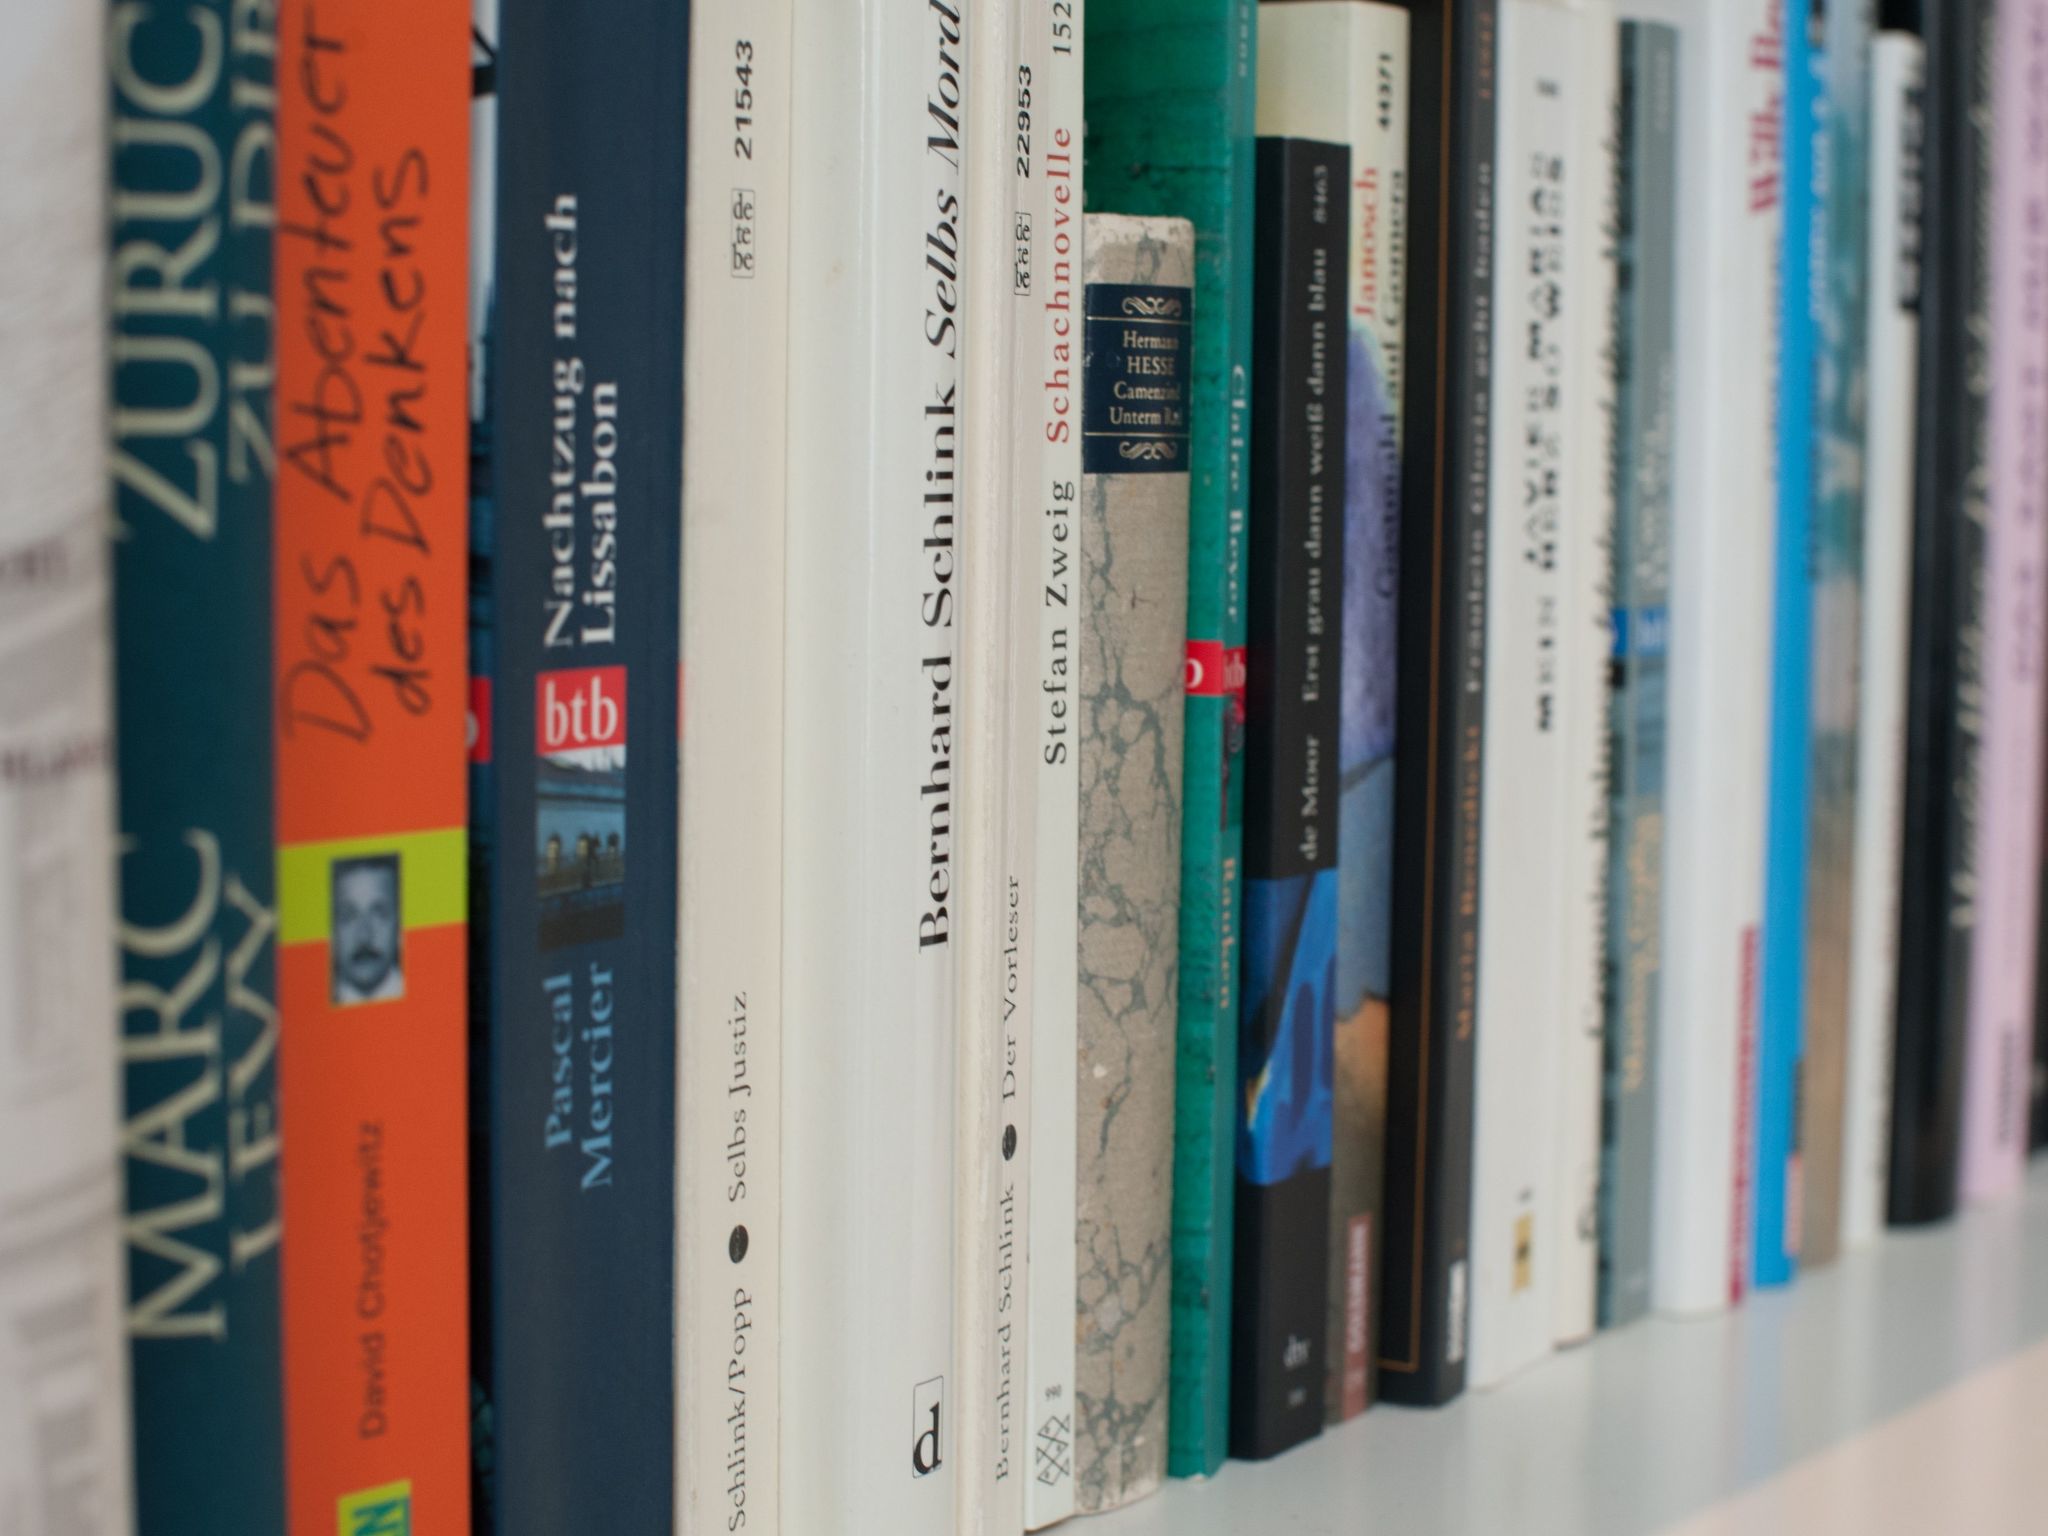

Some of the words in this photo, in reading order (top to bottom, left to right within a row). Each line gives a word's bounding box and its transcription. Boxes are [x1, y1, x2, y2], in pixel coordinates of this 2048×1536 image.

[735, 39, 753, 160] 21543
[927, 0, 962, 177] Mord
[1016, 64, 1032, 179] 22953
[281, 0, 365, 502] Abenteuer
[545, 194, 578, 338] nach
[925, 188, 959, 359] Selbs
[1046, 127, 1071, 444] Schachnovelle
[1308, 248, 1327, 313] blau
[1353, 165, 1380, 319] Janosch
[362, 146, 433, 557] Denkens
[1127, 355, 1175, 375] HESSE
[1307, 320, 1326, 397] dann
[1109, 406, 1161, 425] Unterm
[1231, 364, 1246, 491] Claire
[1306, 401, 1325, 477] weiß
[543, 357, 585, 648] Nachtzug
[581, 380, 618, 645] Lissabon
[921, 377, 957, 628] Schlink
[1046, 480, 1074, 607] Zweig
[1304, 484, 1324, 559] dann
[1228, 509, 1243, 624] Beyer
[1305, 566, 1324, 637] grau
[283, 555, 372, 742] Das
[371, 575, 432, 718] des
[1043, 627, 1068, 766] Stefan
[1302, 643, 1320, 702] Erst
[545, 676, 618, 747] btb
[919, 650, 954, 955] Bernhard
[1301, 734, 1319, 817] Moor
[1300, 827, 1318, 861] de
[1003, 875, 1020, 1018] Vorleser
[543, 971, 573, 1150] Pascal
[580, 962, 613, 1191] Mercier
[728, 991, 751, 1098] Justiz
[1002, 1032, 1018, 1103] Der
[728, 1107, 746, 1203] Selbs
[998, 1183, 1014, 1313] Schlink
[358, 1331, 388, 1441] David
[728, 1287, 752, 1532] Schlink/Popp
[912, 1401, 943, 1476] d
[995, 1322, 1013, 1482] Bernhard
